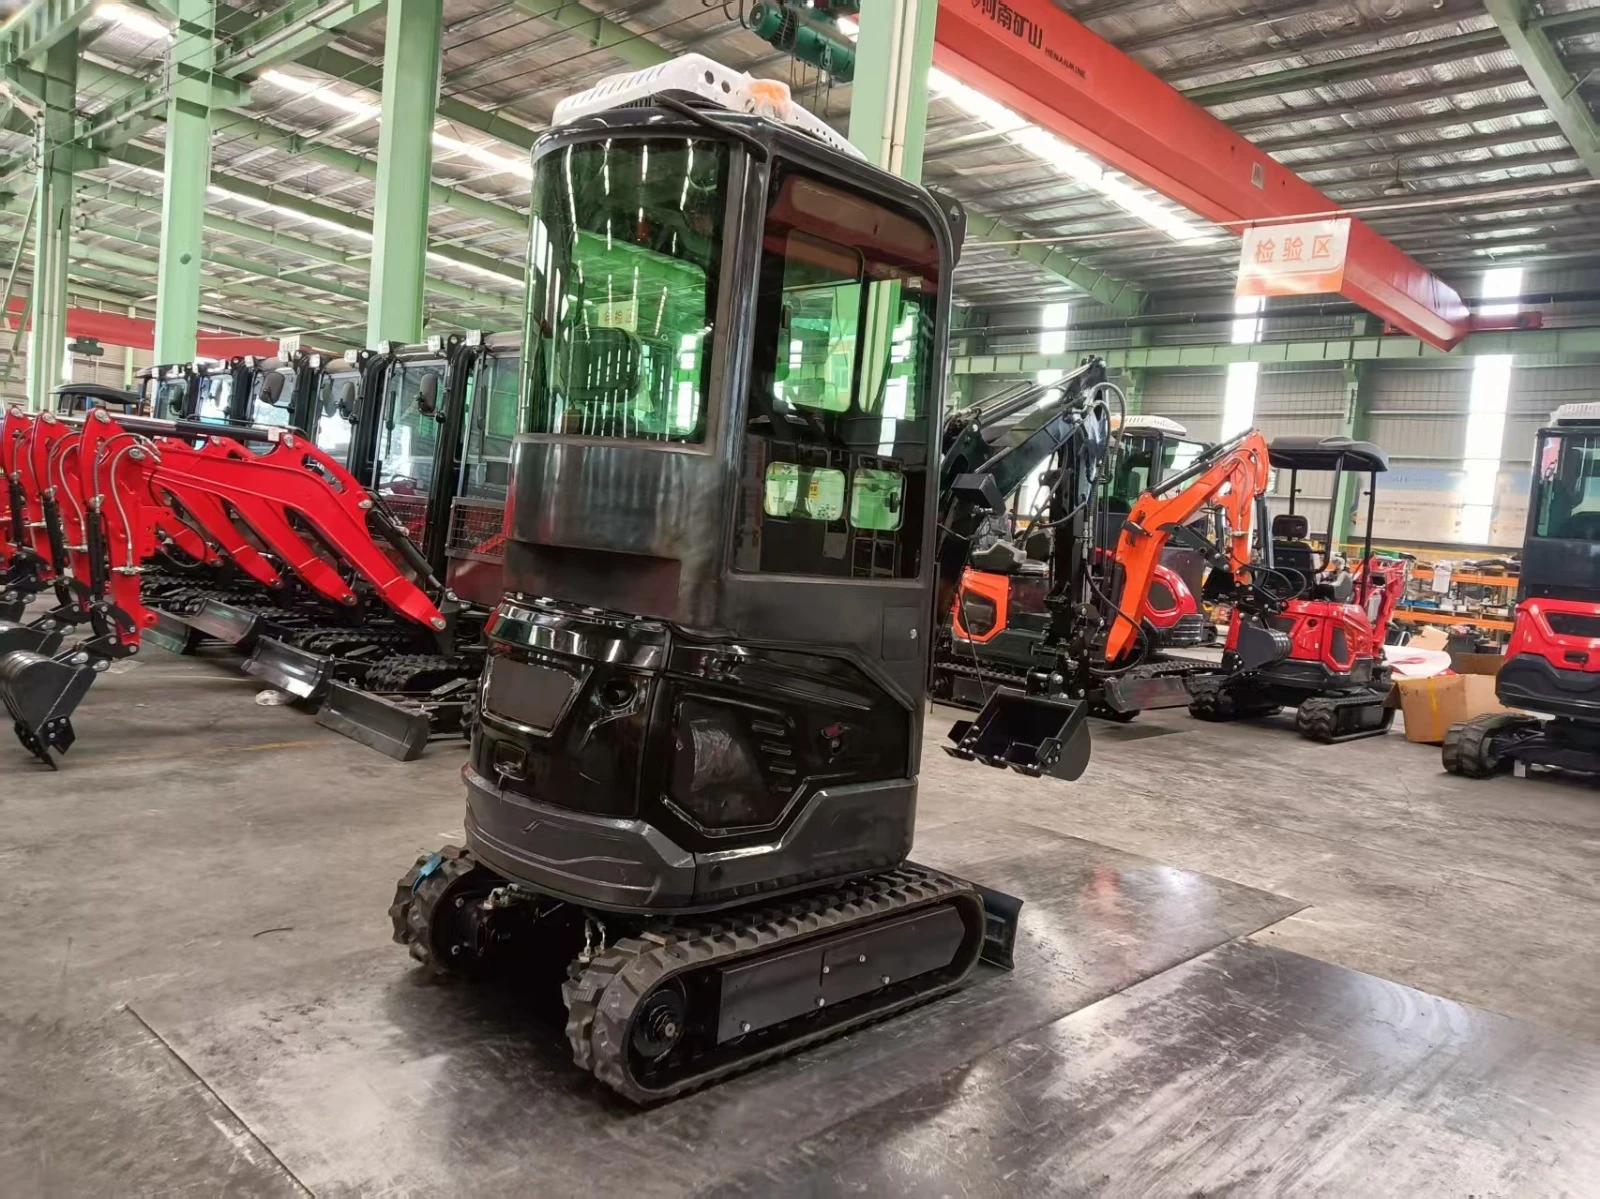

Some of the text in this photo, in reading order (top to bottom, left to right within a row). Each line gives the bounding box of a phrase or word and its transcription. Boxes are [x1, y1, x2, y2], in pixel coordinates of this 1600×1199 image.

[982, 0, 1043, 49] 河南矿山
[1256, 234, 1332, 263] 检验区
